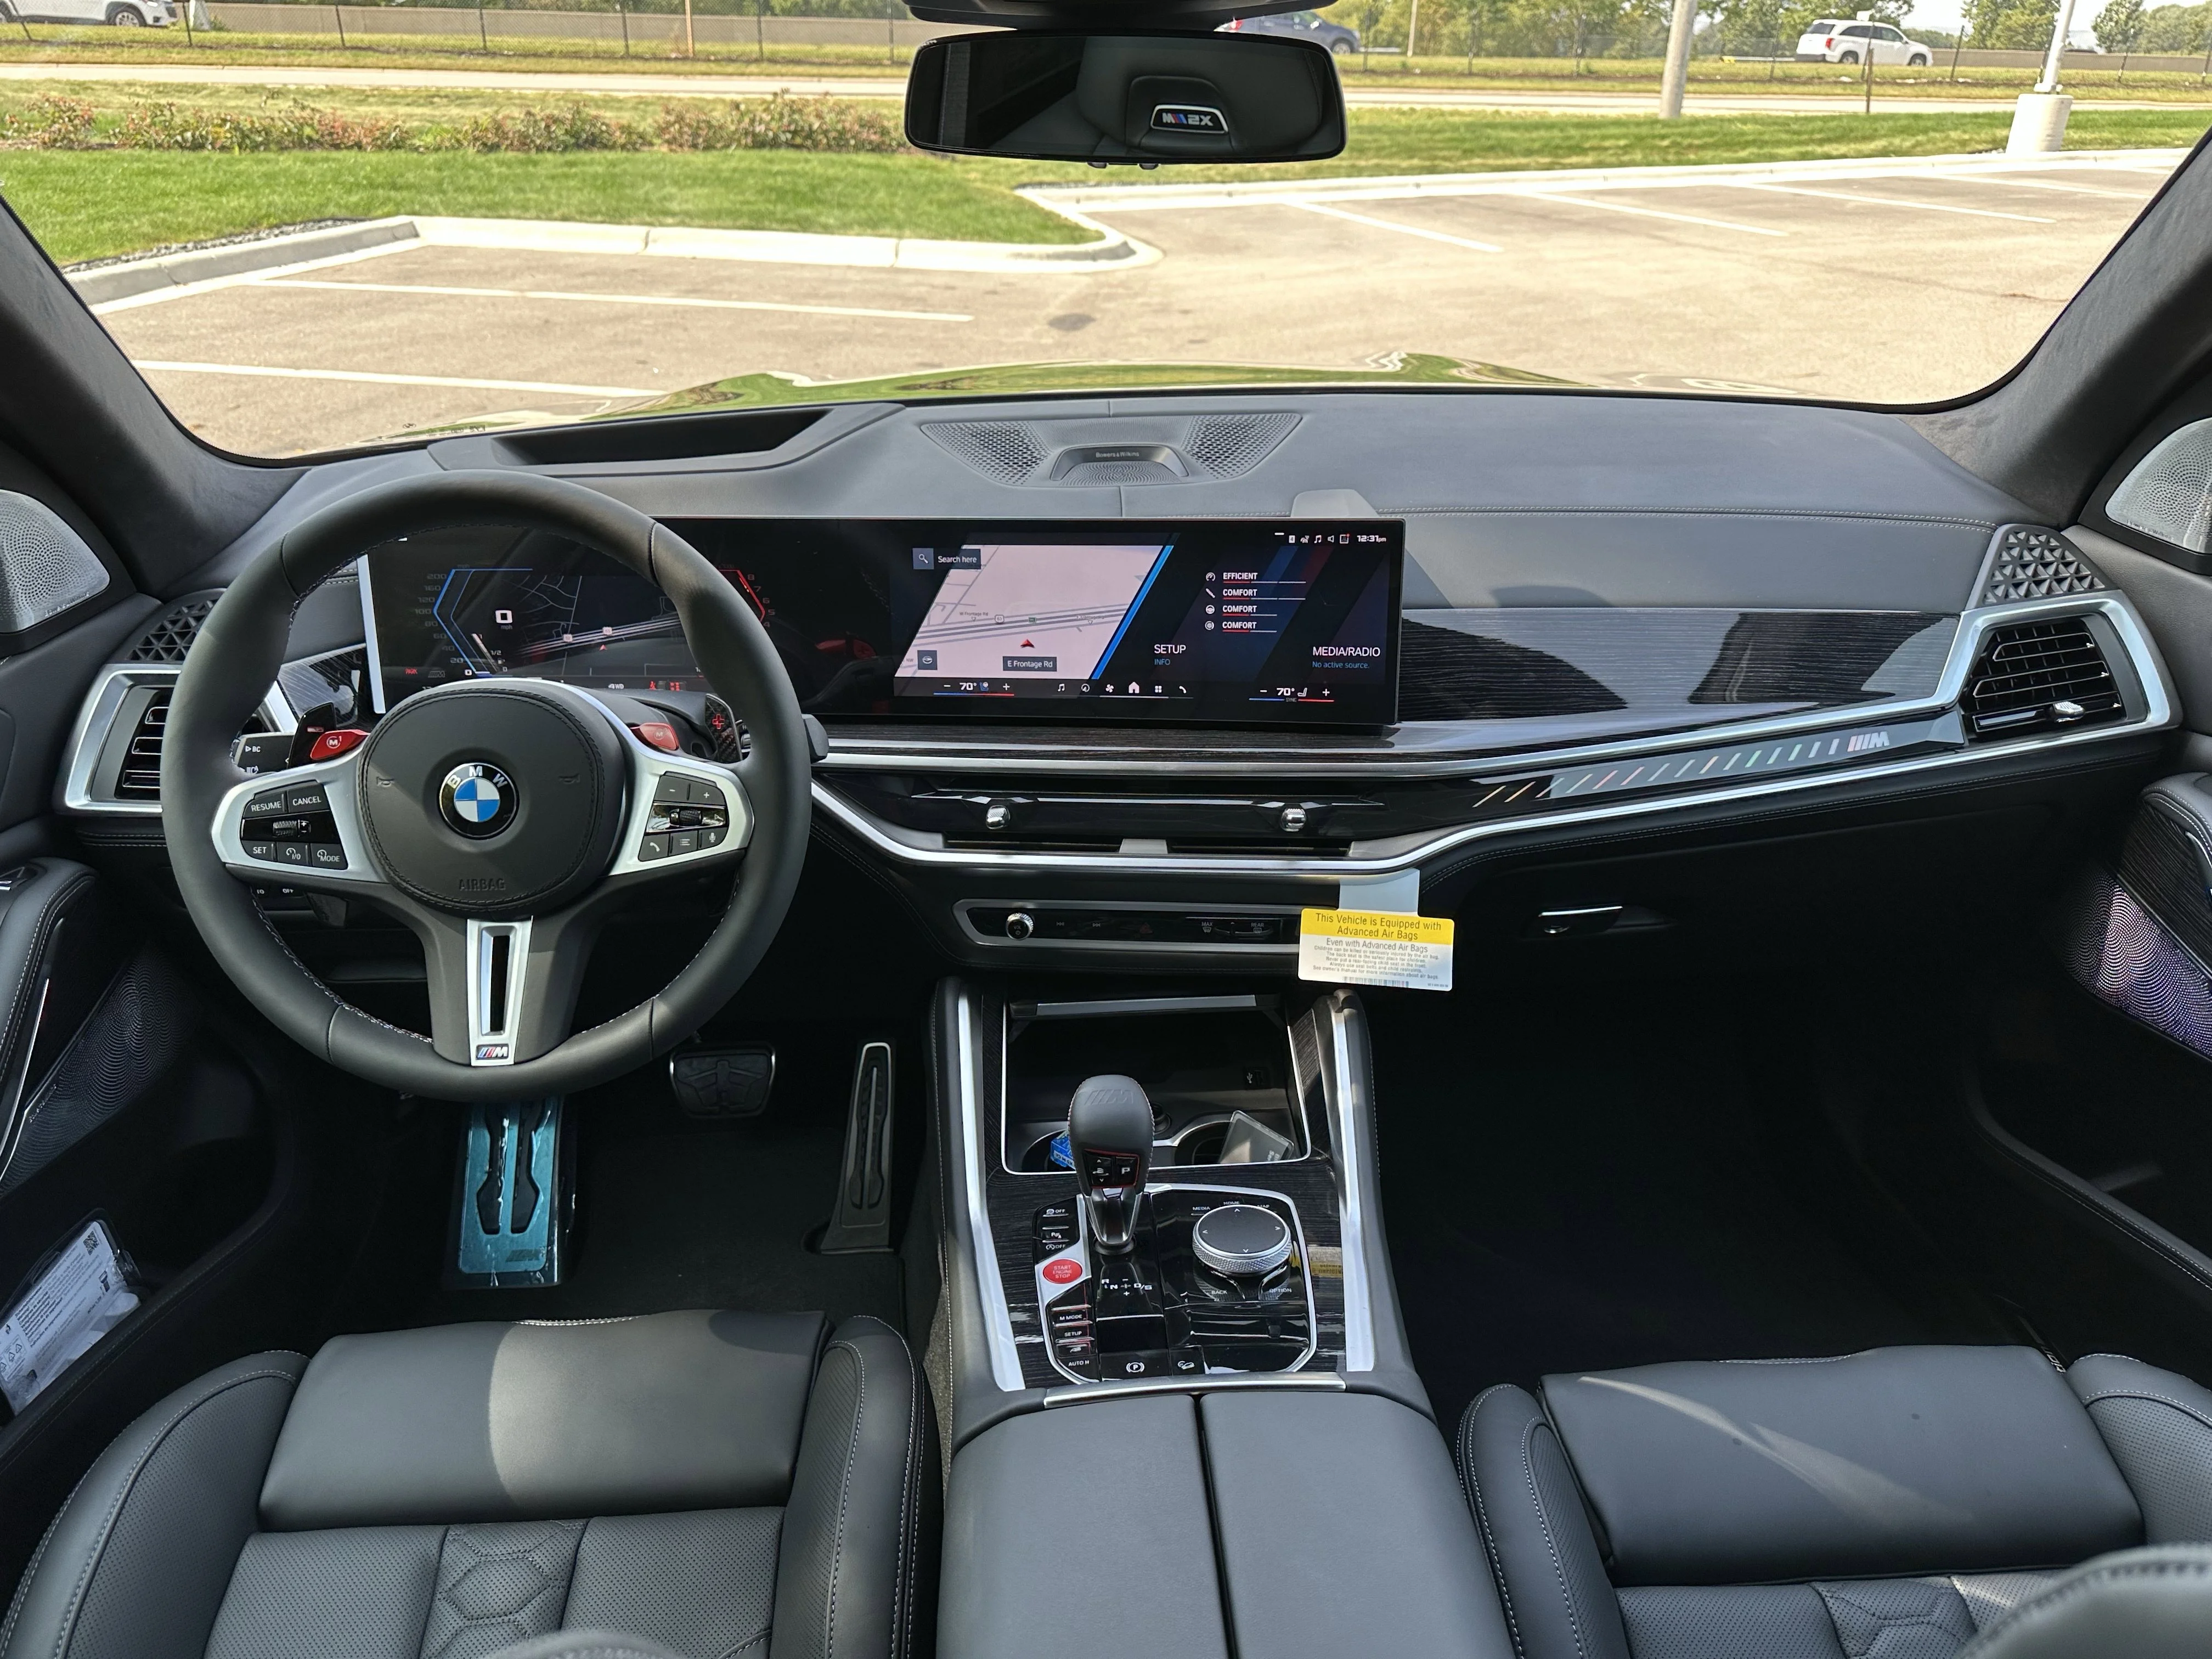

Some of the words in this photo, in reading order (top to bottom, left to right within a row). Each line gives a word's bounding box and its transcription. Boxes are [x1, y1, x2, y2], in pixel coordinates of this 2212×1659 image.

[495, 610, 512, 623] 0
[1154, 645, 1186, 654] SETUP
[1313, 647, 1381, 657] MEDIA/RADIO
[1013, 661, 1042, 669] Frontage
[447, 766, 508, 789] BMW
[251, 801, 282, 812] RESUME
[292, 795, 322, 806] CANCEL
[459, 878, 506, 891] AIRBAG
[1316, 912, 1334, 923] This
[1336, 914, 1367, 925] Vehicle
[1370, 917, 1377, 926] is
[1380, 917, 1420, 929] Equipped
[1423, 922, 1441, 930] with
[1337, 926, 1379, 937] Advanced
[1381, 929, 1394, 938] Air
[1397, 930, 1418, 941] Bags
[1327, 938, 1343, 946] Even
[1345, 939, 1360, 947] with
[1362, 940, 1396, 950] Advanced
[1410, 944, 1428, 953] Bags
